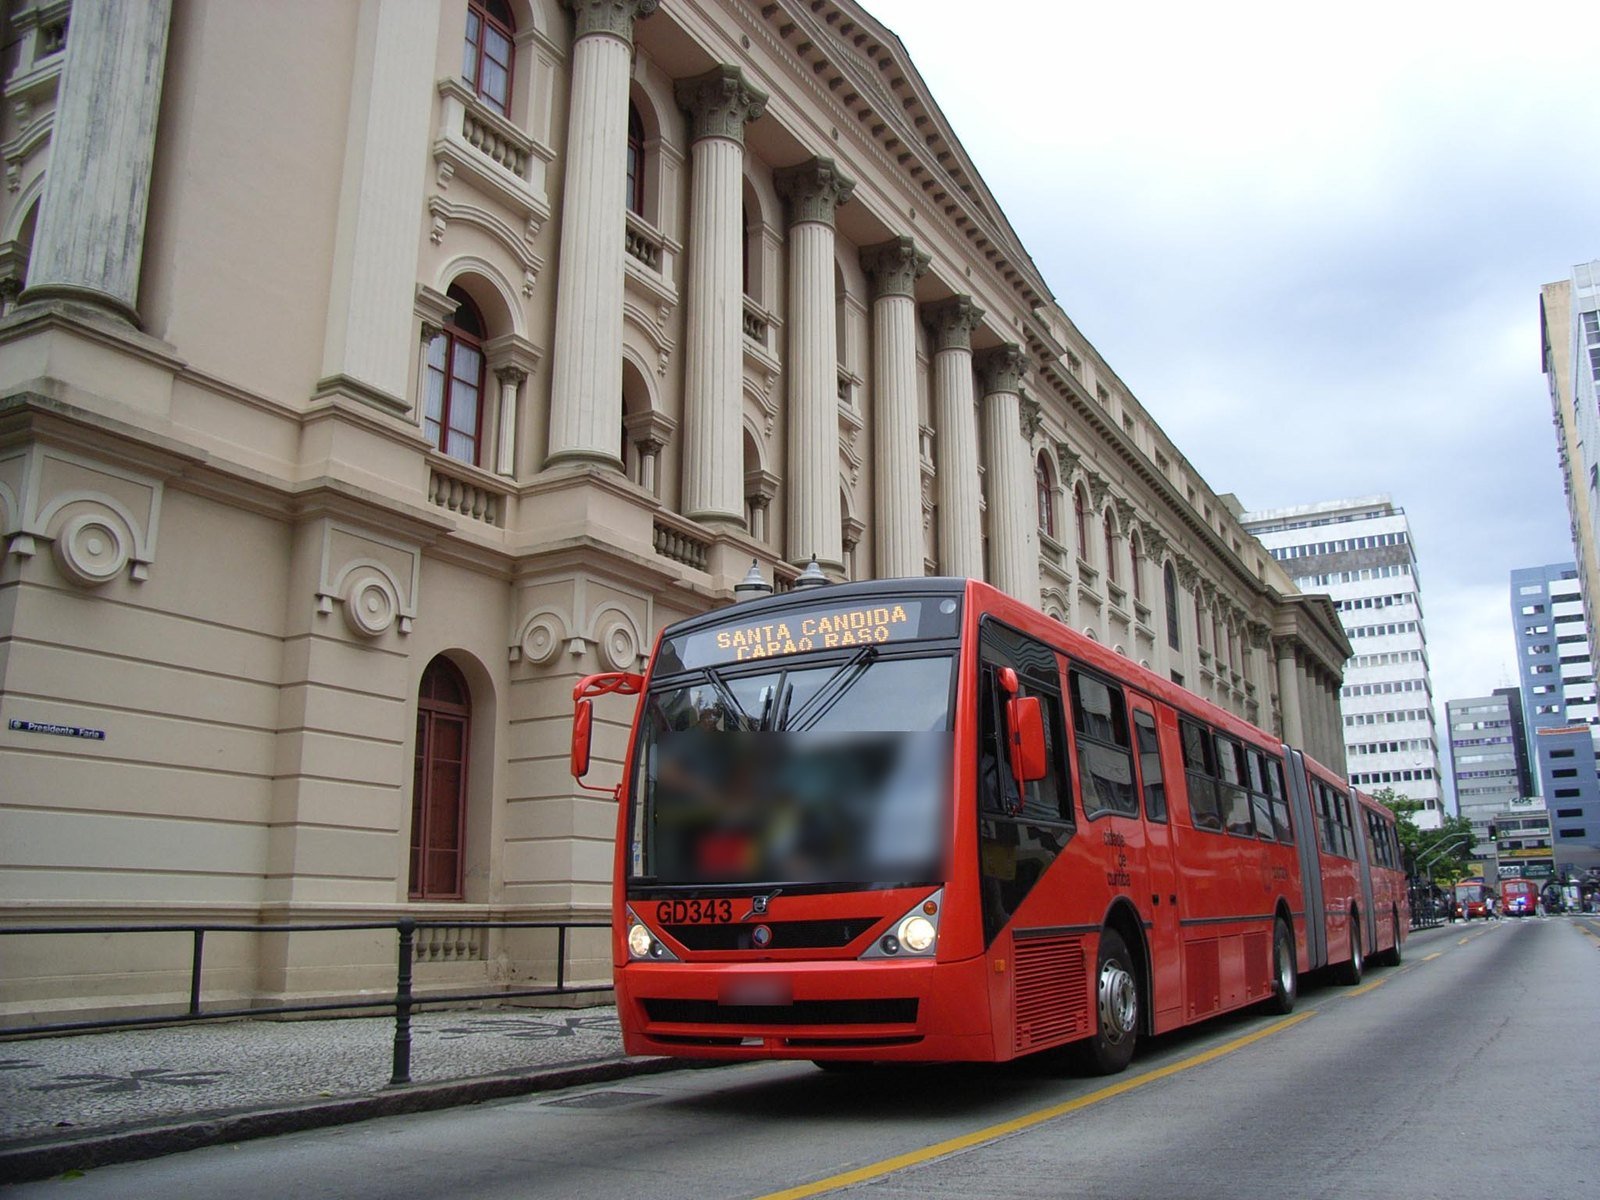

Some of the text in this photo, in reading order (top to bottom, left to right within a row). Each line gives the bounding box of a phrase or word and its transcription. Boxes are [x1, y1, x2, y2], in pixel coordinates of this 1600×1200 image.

[717, 605, 907, 648] SANTA CANDIDA
[737, 625, 889, 660] CAPAO RASO
[28, 722, 99, 738] Presidente Faria
[656, 899, 732, 923] GD343
